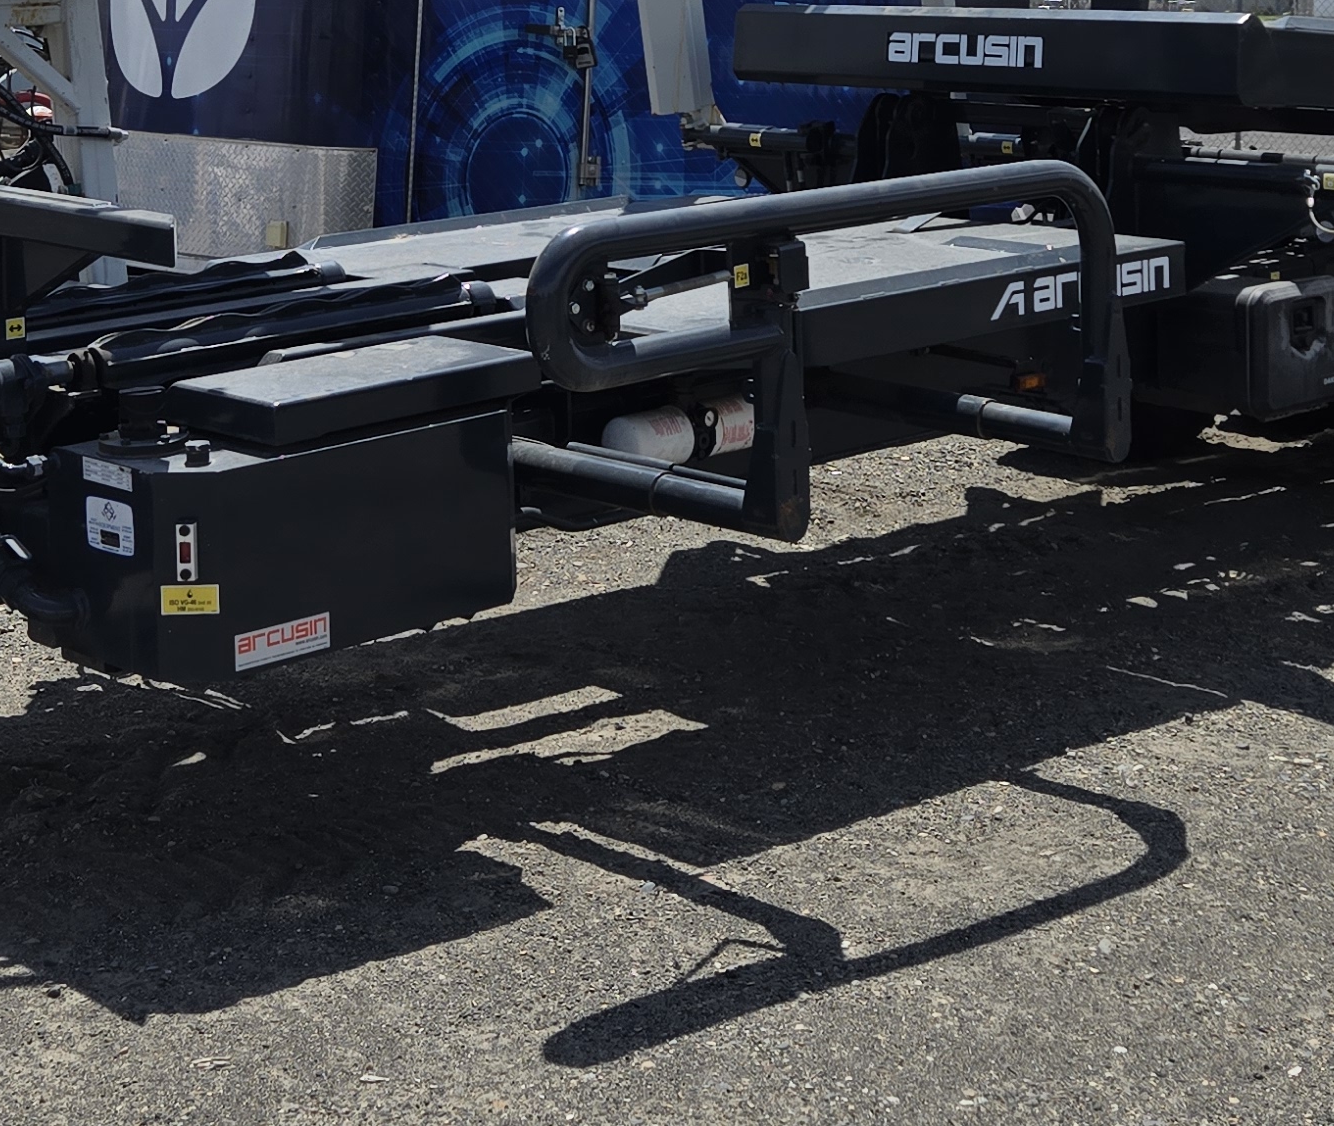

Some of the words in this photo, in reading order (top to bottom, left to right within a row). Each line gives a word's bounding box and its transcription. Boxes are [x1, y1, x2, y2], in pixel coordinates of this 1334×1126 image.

[888, 32, 1043, 68] arcusin
[1034, 256, 1170, 313] arsin
[238, 617, 327, 655] arcusin
